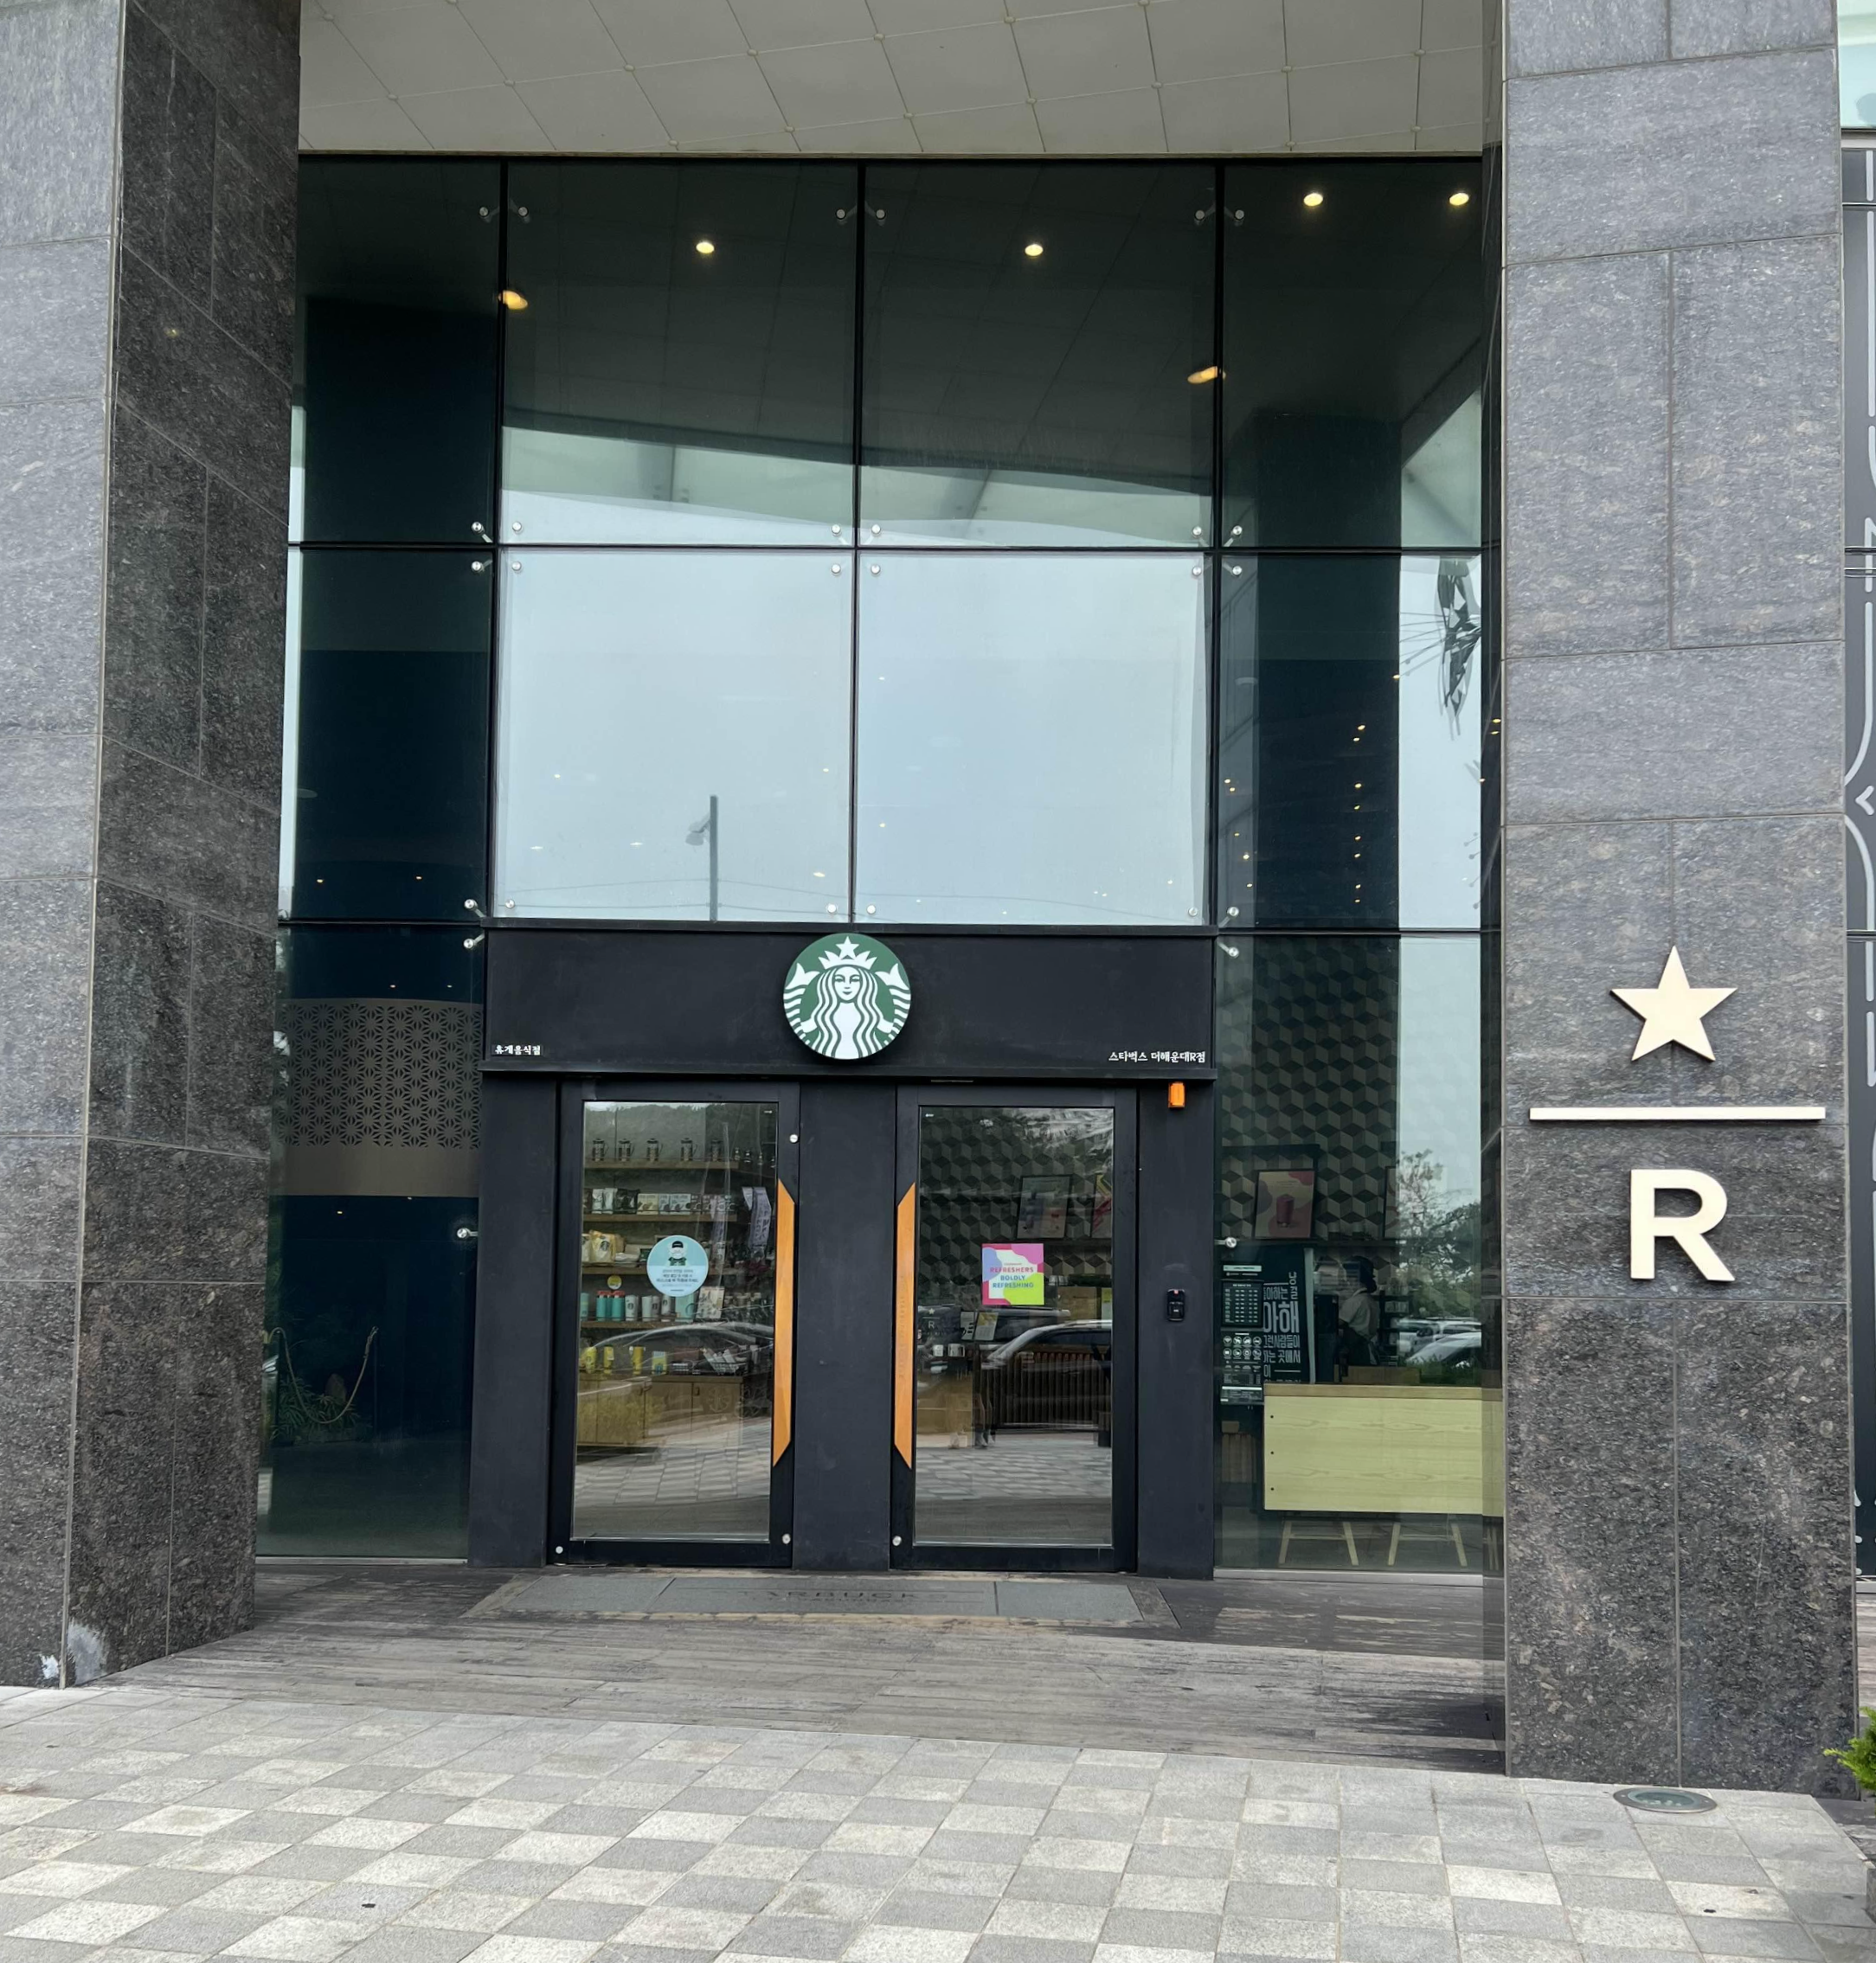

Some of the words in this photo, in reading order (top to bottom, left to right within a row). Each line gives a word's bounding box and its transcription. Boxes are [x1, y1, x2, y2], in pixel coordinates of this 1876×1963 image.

[495, 1044, 541, 1055] 휴게음식점
[1108, 1050, 1148, 1062] 스타벅스
[1151, 1050, 1205, 1063] 더해운대R점
[1630, 1169, 1736, 1281] R
